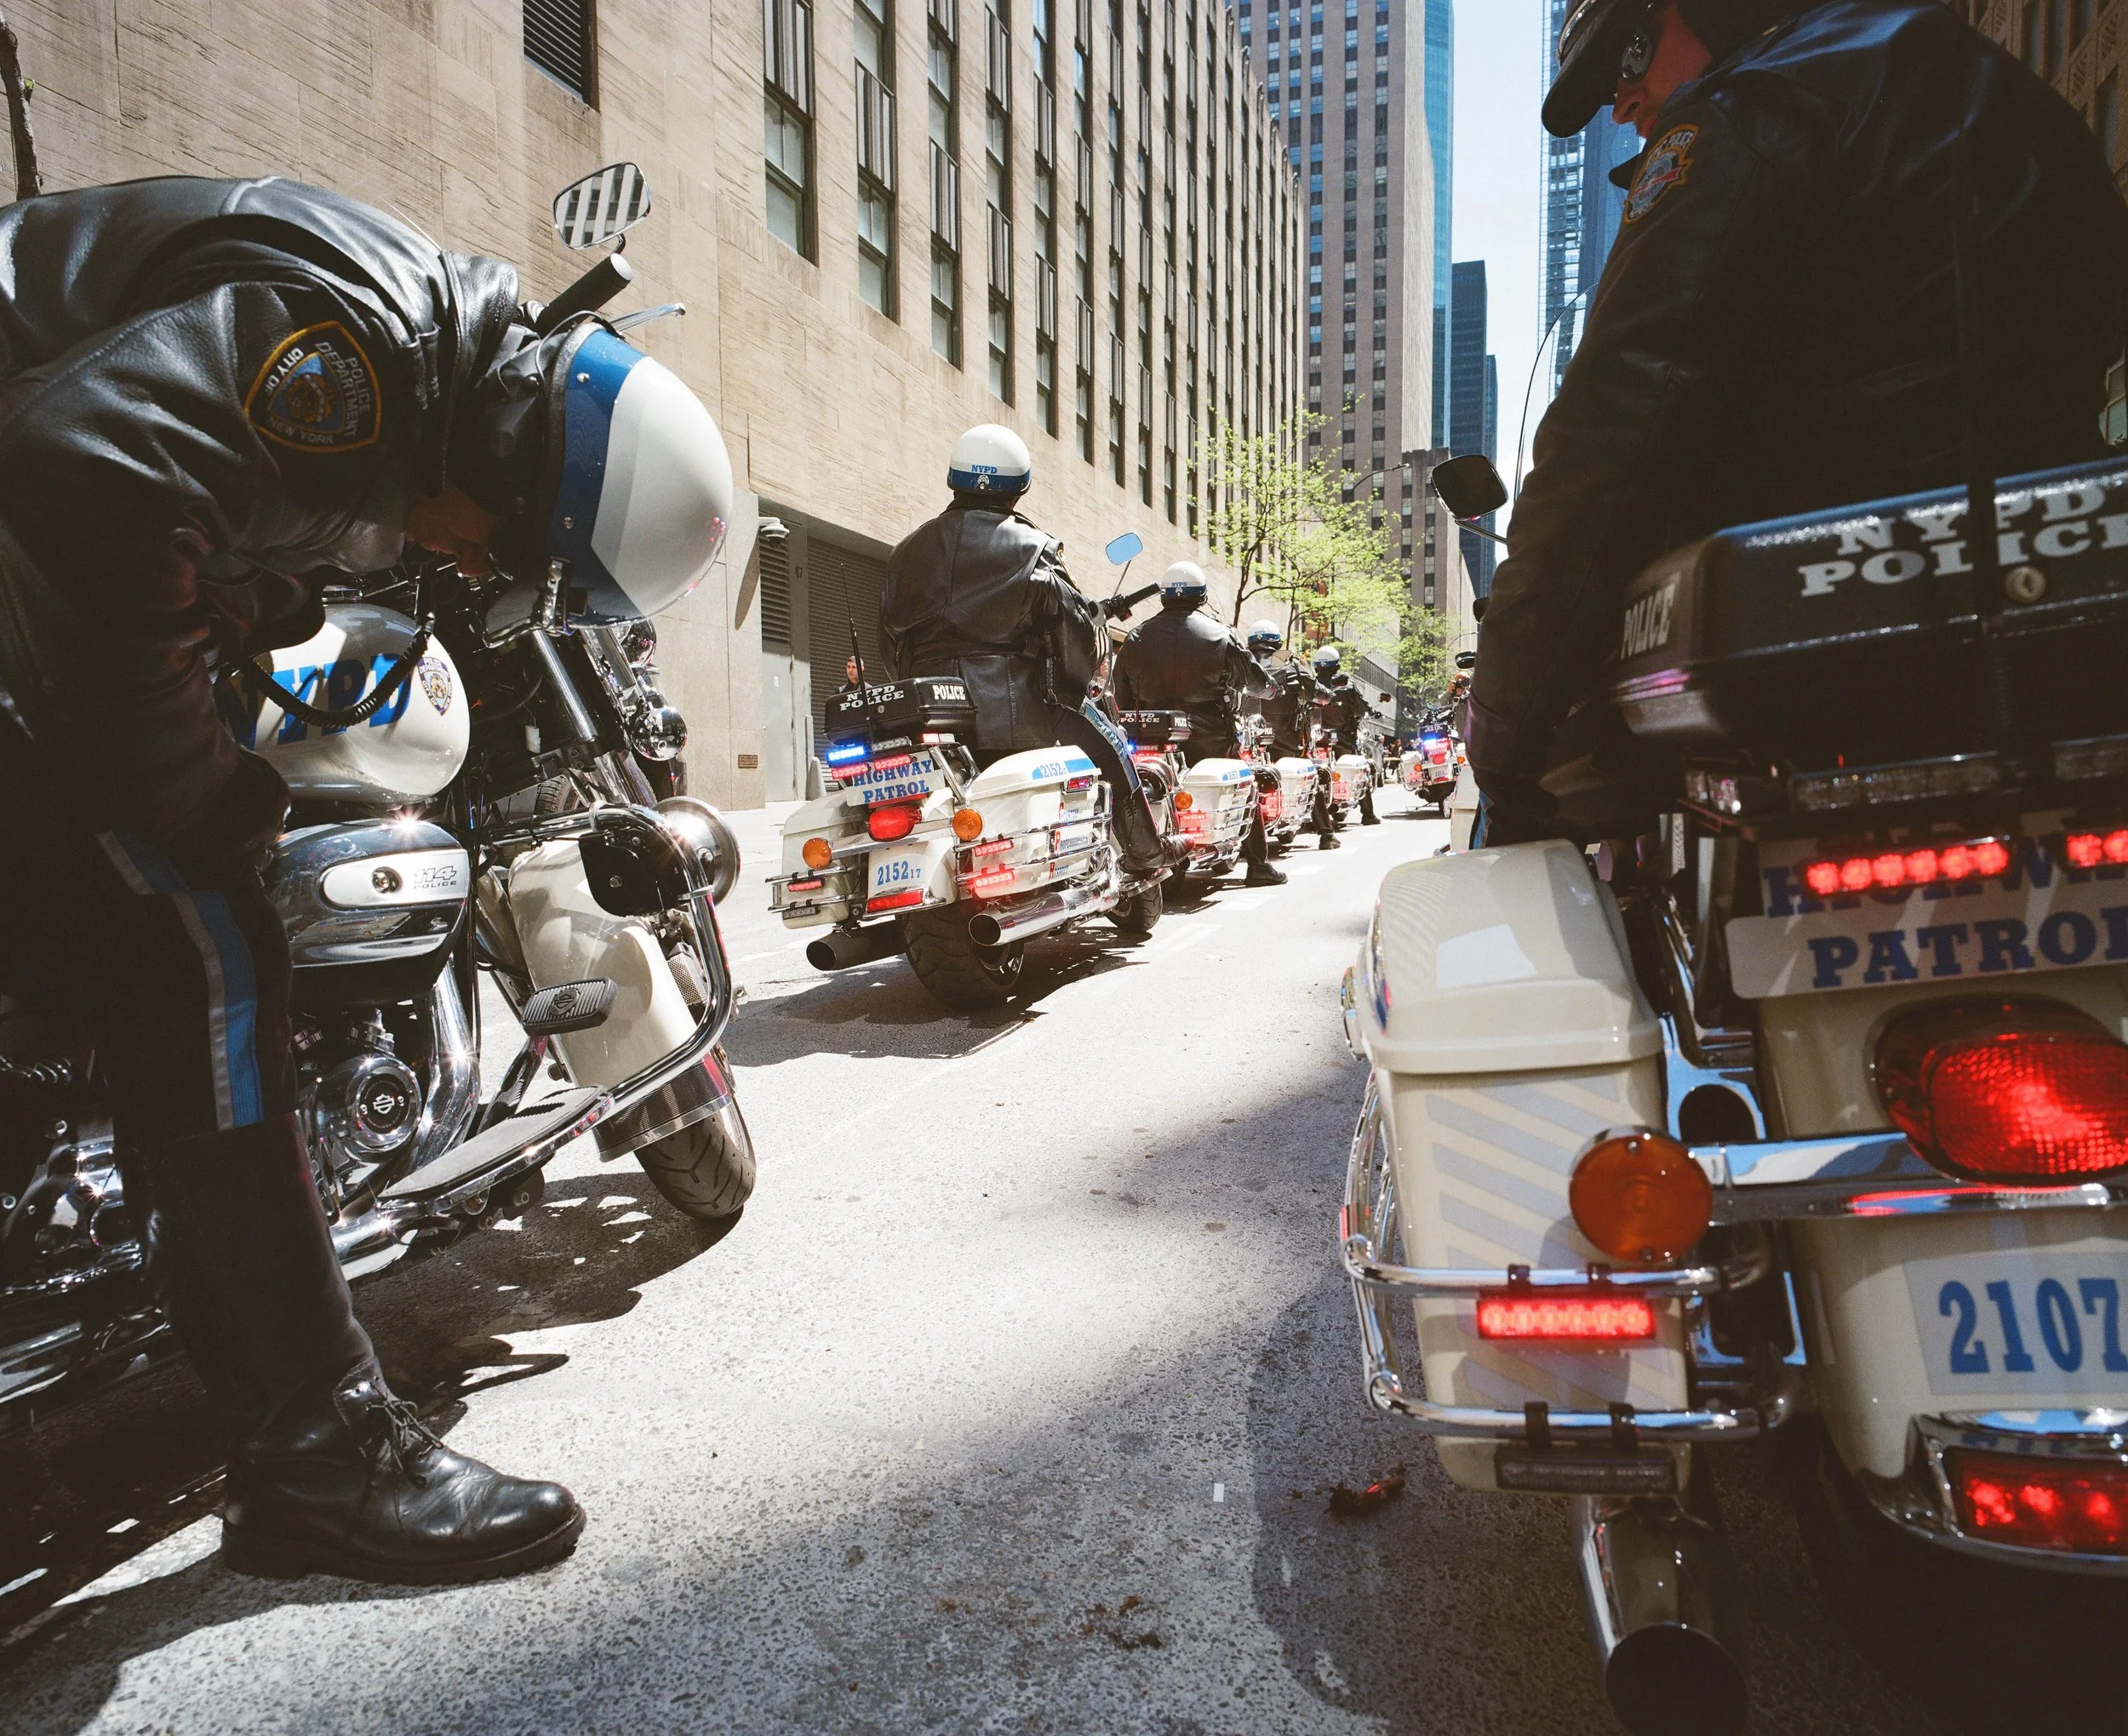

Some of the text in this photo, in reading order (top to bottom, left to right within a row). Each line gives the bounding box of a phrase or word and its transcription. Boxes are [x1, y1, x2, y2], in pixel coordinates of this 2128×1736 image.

[277, 347, 304, 375] CITY
[315, 341, 359, 437] DEPARTMENT
[345, 357, 370, 413] POLICE
[300, 432, 334, 444] YORK
[971, 465, 998, 474] NYPD
[1836, 483, 2106, 555] NYPD
[1621, 579, 1678, 660] POLICE
[839, 690, 905, 711] POLICE
[932, 684, 966, 700] POLICE
[853, 759, 932, 787] HIGHWAY
[1040, 762, 1062, 778] 2152
[862, 780, 930, 804] PATROL
[414, 865, 457, 884] 114
[414, 880, 457, 890] POLICE
[1938, 1278, 2128, 1374] 2107
